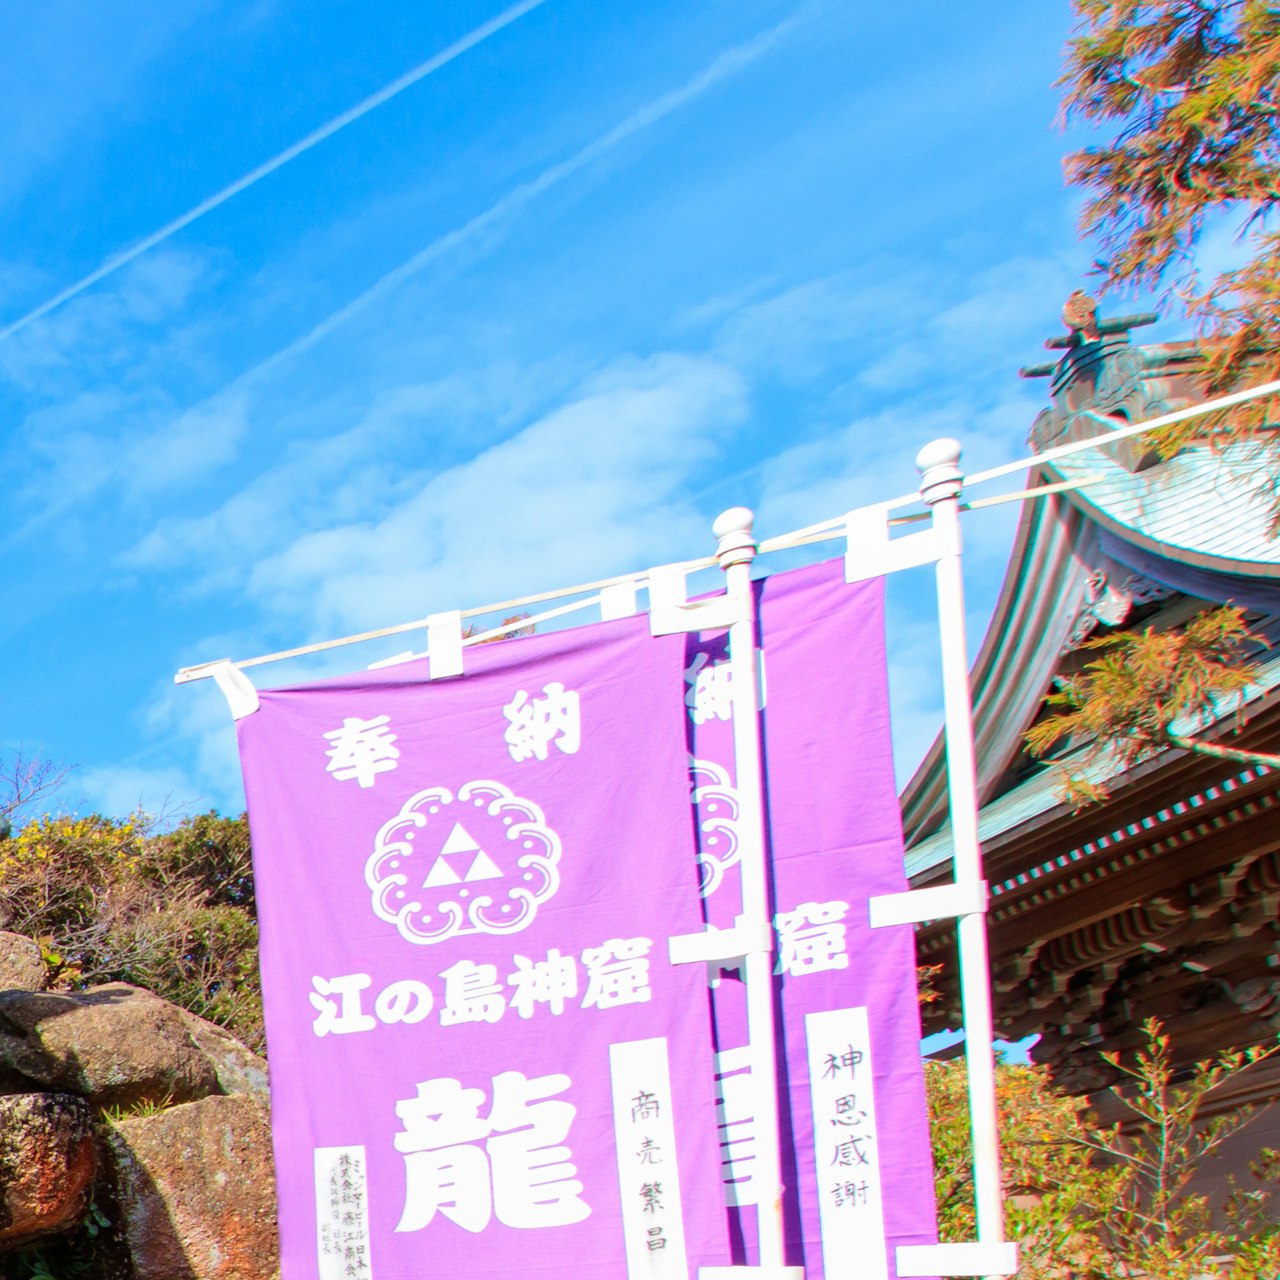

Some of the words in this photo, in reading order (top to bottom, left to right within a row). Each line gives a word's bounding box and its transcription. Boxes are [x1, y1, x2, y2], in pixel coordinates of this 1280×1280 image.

[322, 682, 582, 789] 奉納
[309, 937, 654, 1038] 江の島神窟
[630, 1090, 668, 1252] 商売繁昌
[820, 1044, 872, 1208] 神恩感謝
